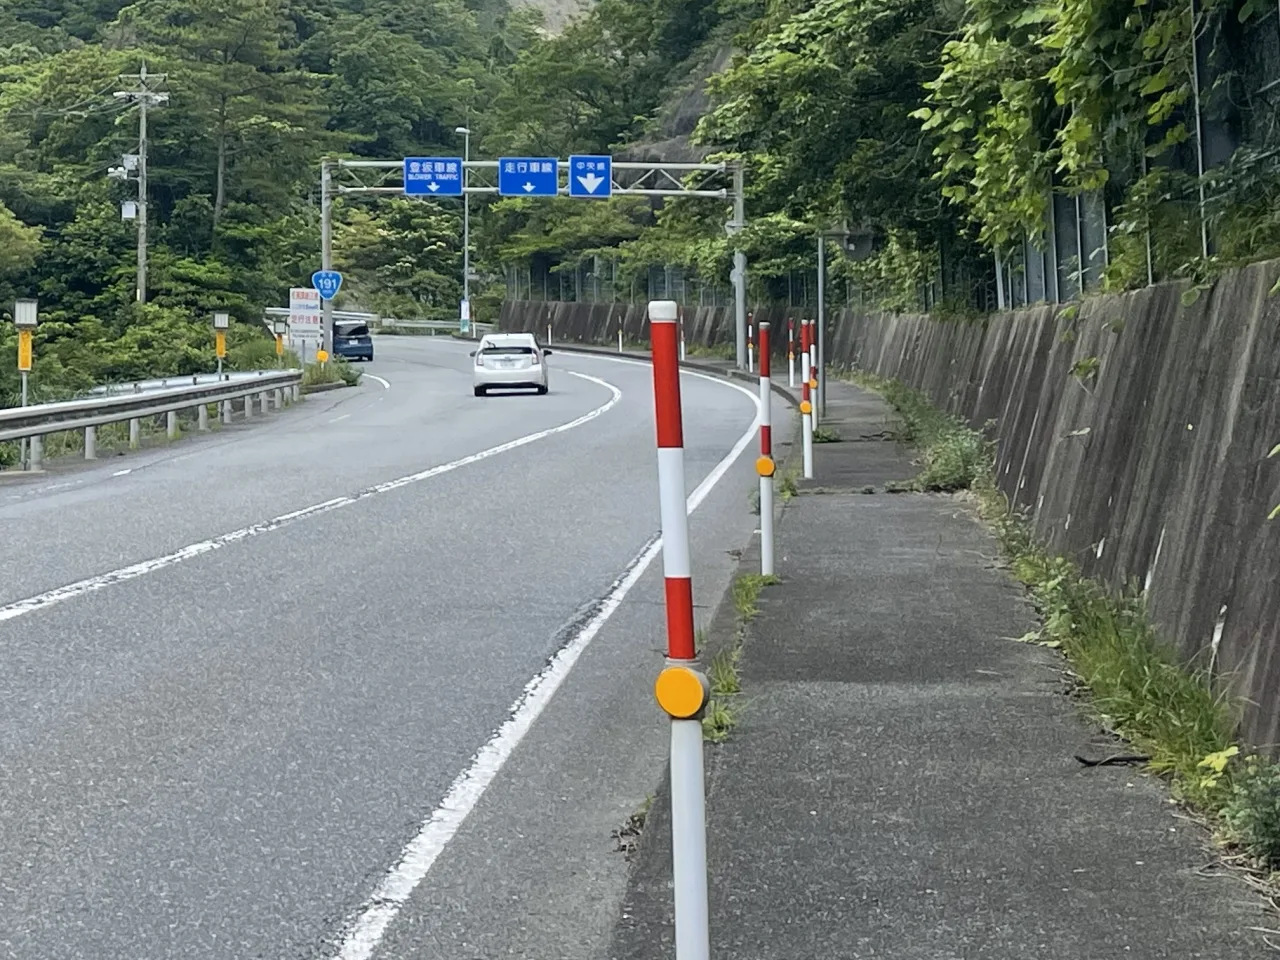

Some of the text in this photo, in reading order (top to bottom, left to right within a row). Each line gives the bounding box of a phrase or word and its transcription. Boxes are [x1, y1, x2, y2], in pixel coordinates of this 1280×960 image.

[409, 161, 458, 173] 登坂車線
[504, 162, 553, 173] 走行車線
[576, 161, 606, 171] 中央線
[319, 278, 337, 289] 191
